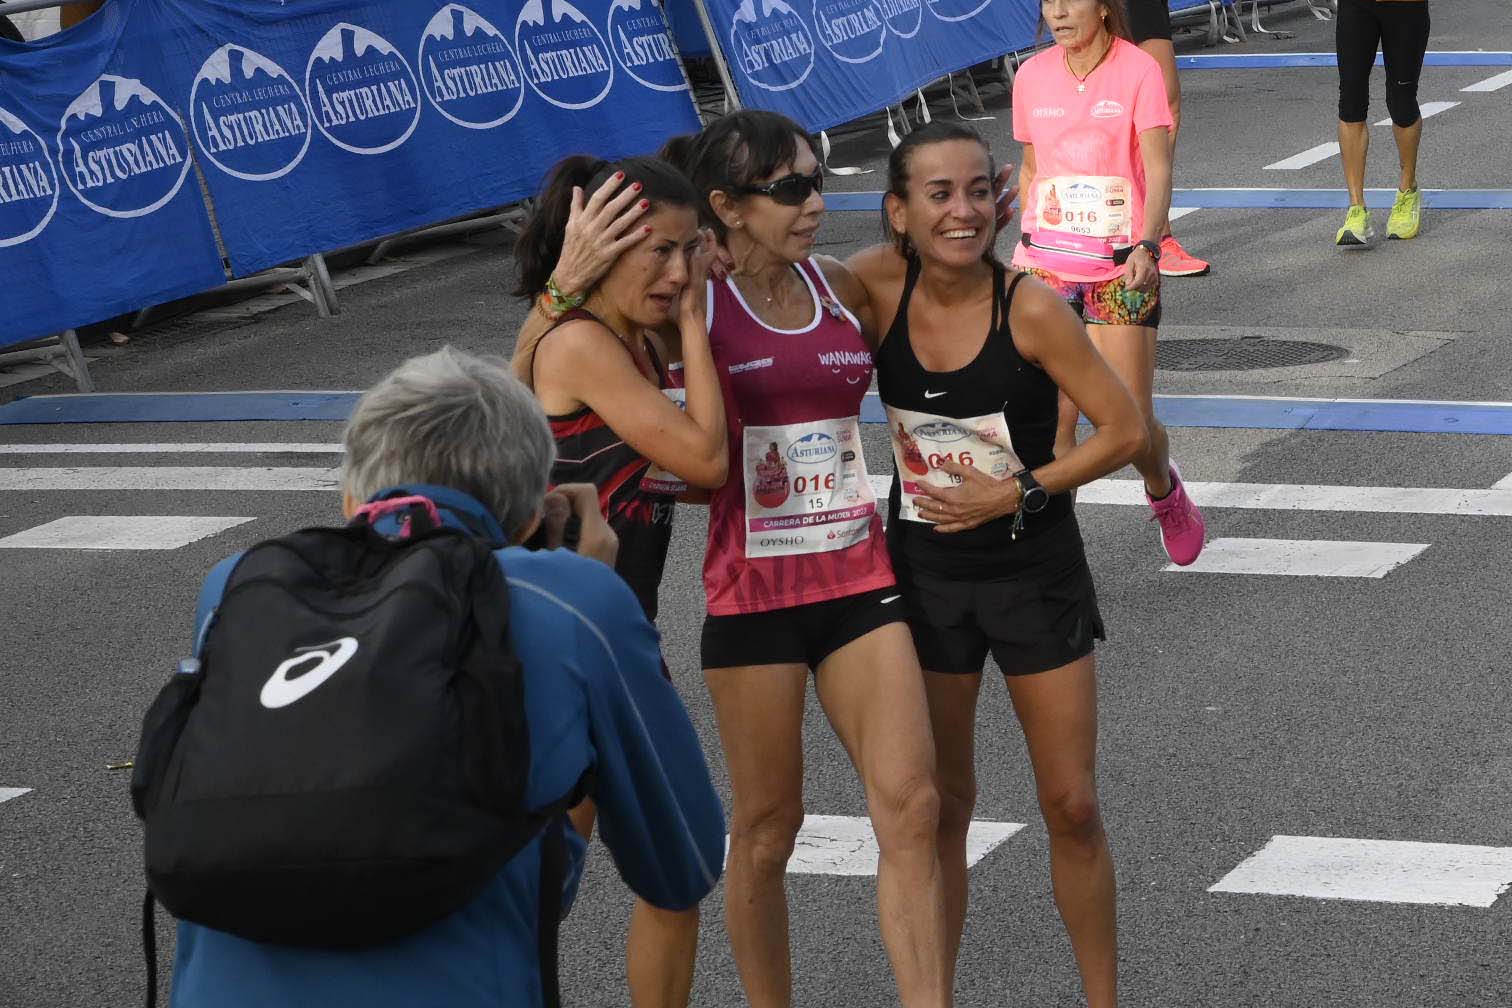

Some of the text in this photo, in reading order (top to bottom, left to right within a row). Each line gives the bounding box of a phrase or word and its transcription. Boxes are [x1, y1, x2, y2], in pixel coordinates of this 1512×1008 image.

[626, 16, 658, 31] CENTRAL
[532, 31, 560, 47] CENTRAL
[617, 23, 680, 69] ASTUR
[438, 47, 470, 62] CENTRAL
[523, 41, 609, 84] ASTURIANA
[326, 60, 401, 86] CENTRAL LECHERA
[428, 53, 520, 102] ASTURIANA
[213, 91, 250, 109] CENTRAL
[316, 77, 416, 127] ASTURIANA
[81, 125, 124, 144] CENTRAL
[202, 102, 306, 154] ASTURIANA
[0, 161, 53, 204] RIANA
[1065, 210, 1097, 222] 016
[791, 442, 836, 459] ASTURIANA
[793, 473, 835, 494] 016
[808, 499, 823, 509] 15
[764, 518, 801, 529] CARRERA
[802, 516, 815, 526] DE
[815, 514, 827, 524] LA
[760, 535, 804, 548] OYSHO
